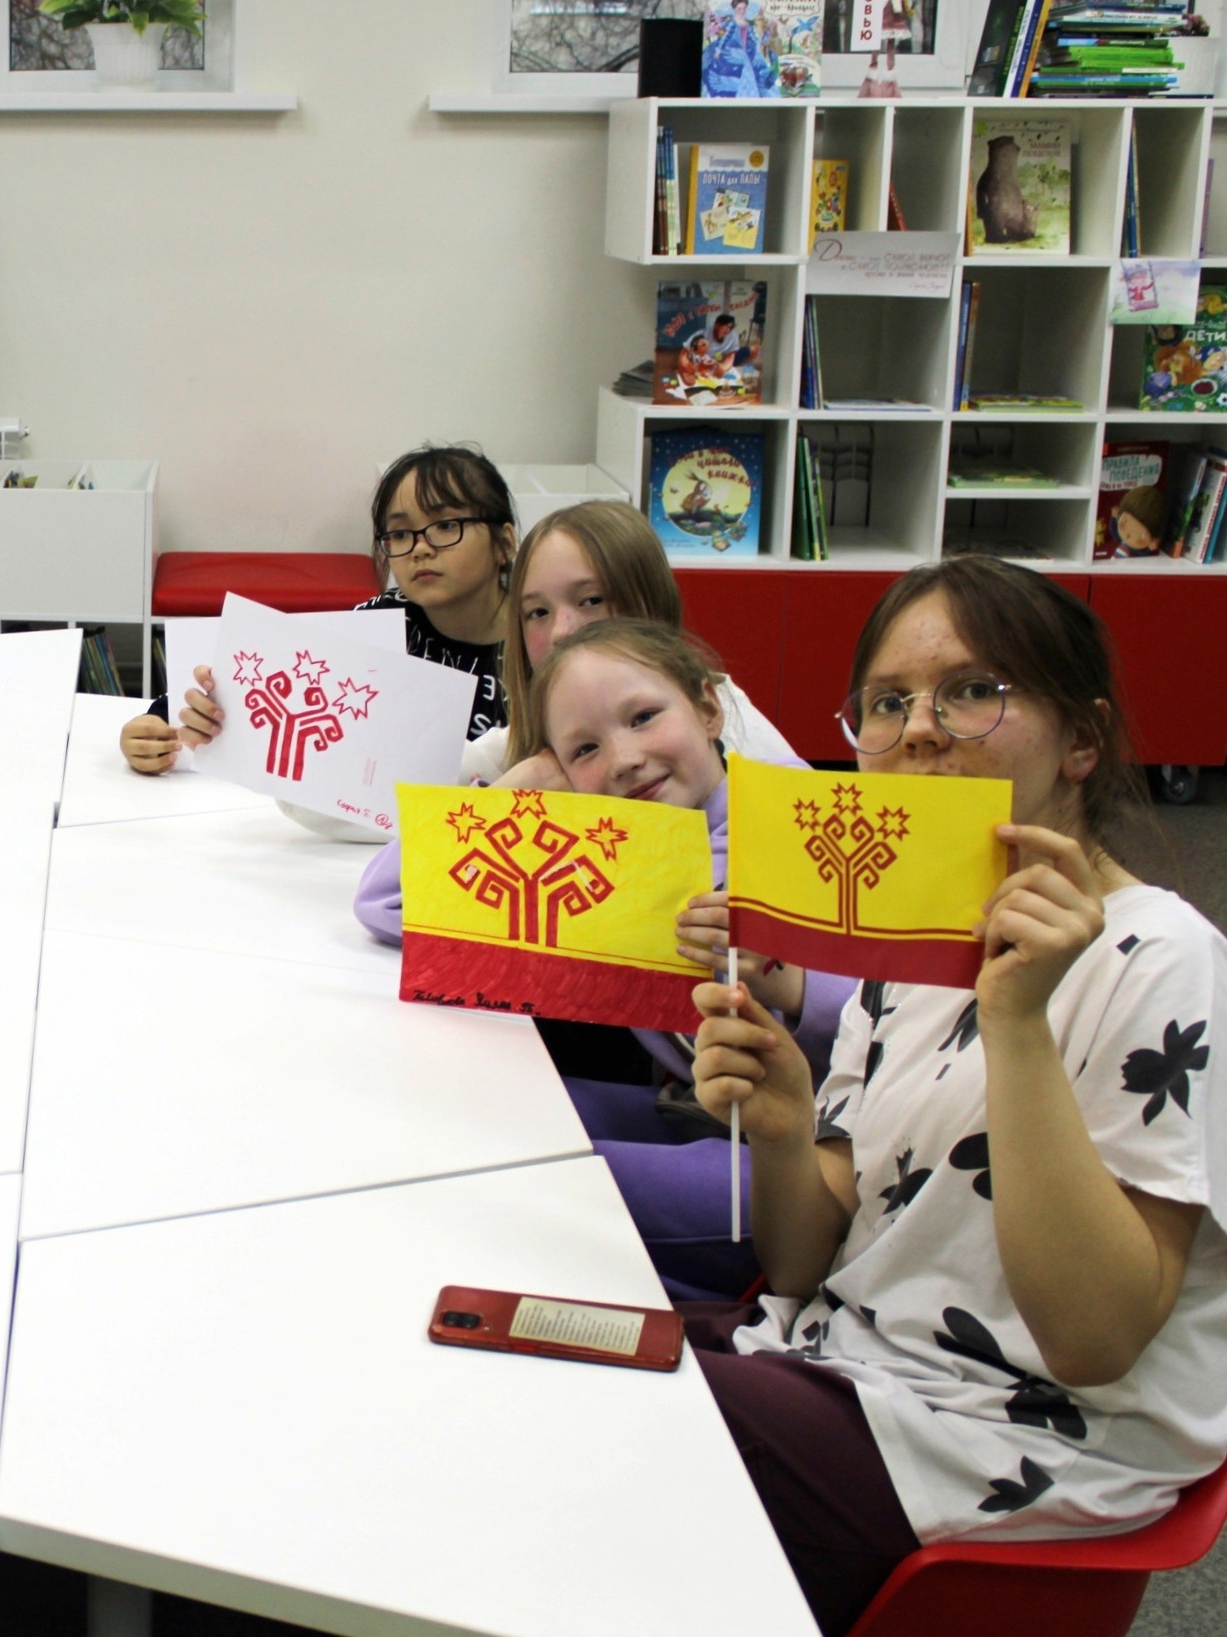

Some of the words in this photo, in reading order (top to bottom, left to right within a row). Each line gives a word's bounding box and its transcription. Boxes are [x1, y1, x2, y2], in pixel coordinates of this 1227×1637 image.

[702, 173, 725, 184] ПОЧТА
[726, 177, 738, 185] для
[739, 173, 761, 184] ПАПЫ
